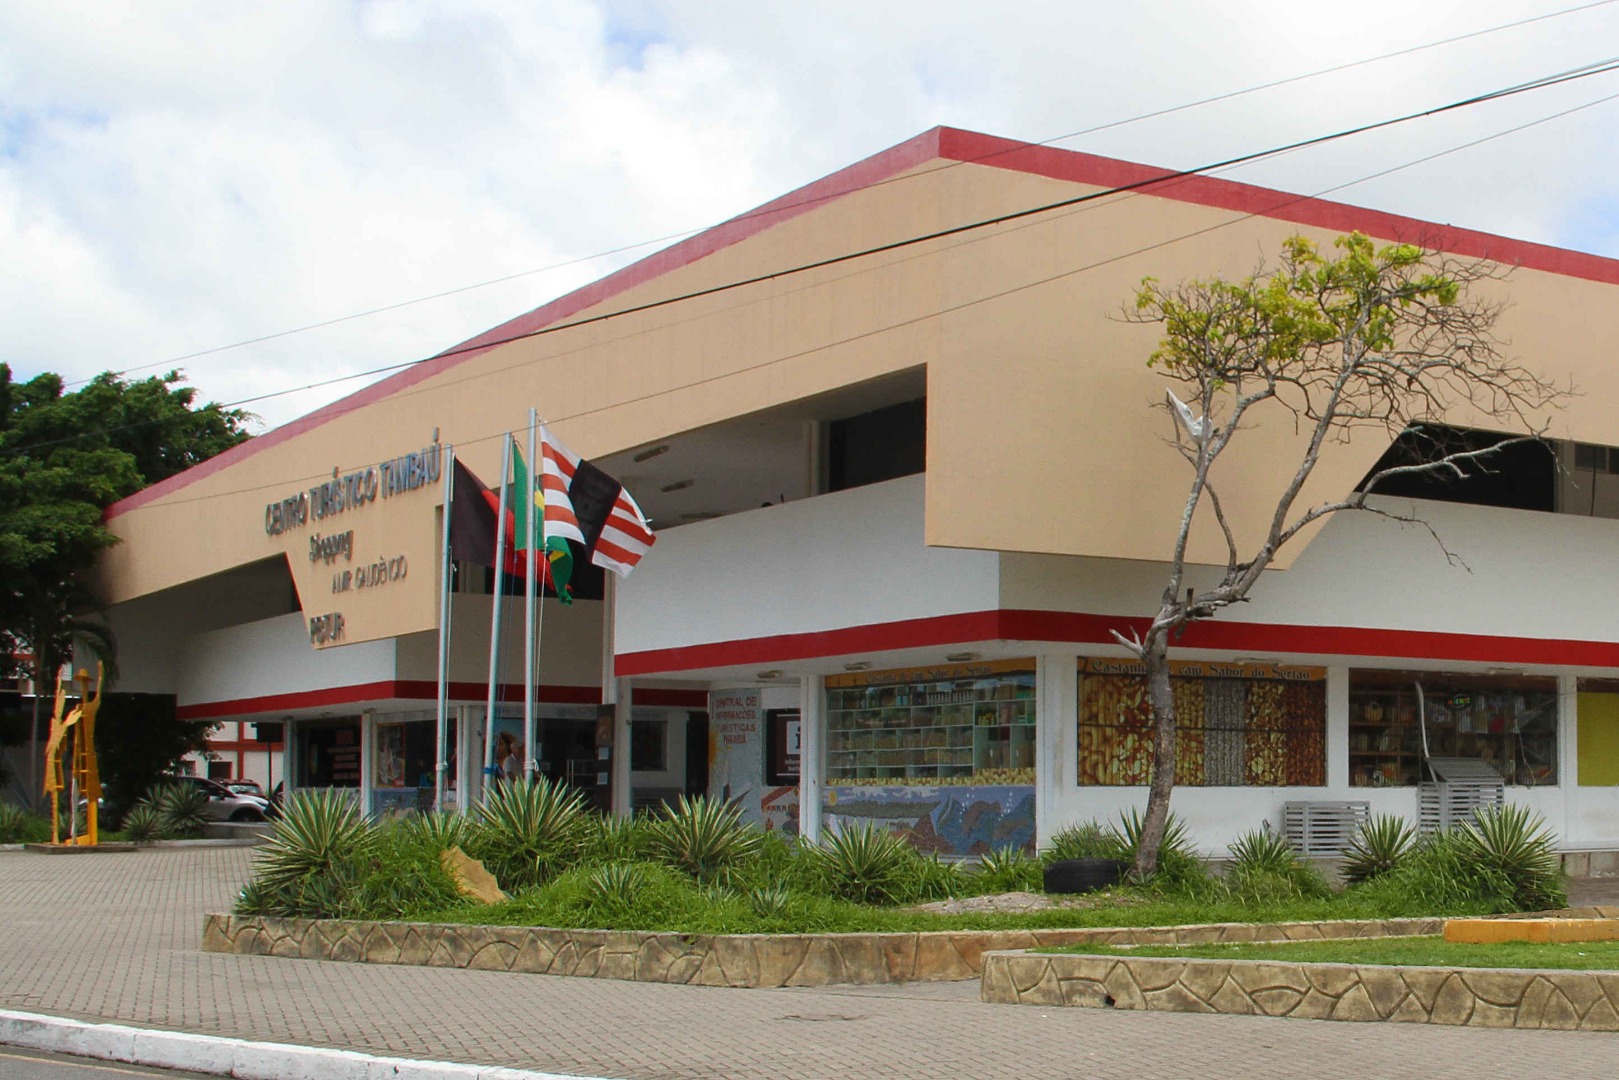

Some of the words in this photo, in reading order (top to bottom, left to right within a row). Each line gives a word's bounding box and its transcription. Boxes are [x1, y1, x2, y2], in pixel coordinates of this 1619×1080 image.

[265, 491, 309, 535] CENTRO
[1209, 665, 1244, 677] Sabor
[1251, 667, 1265, 678] do
